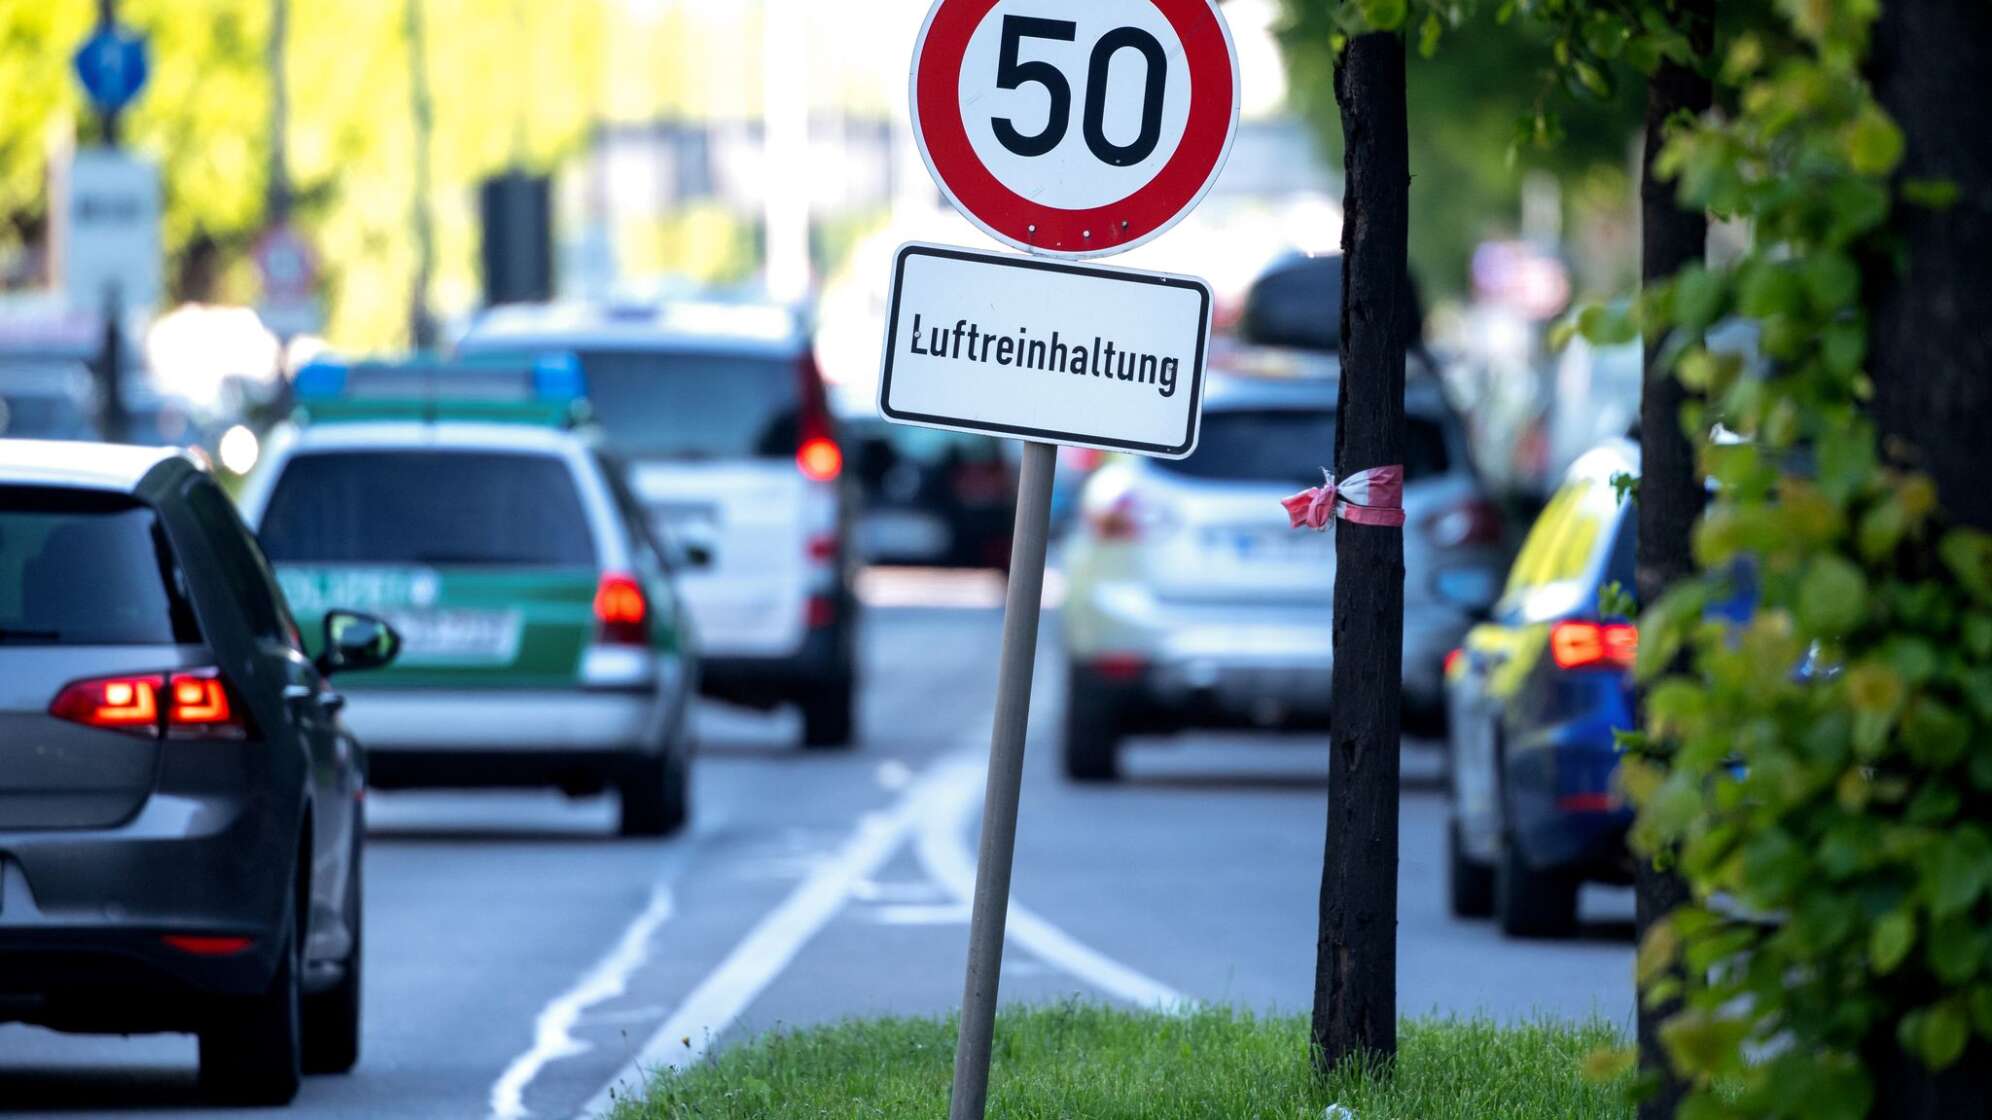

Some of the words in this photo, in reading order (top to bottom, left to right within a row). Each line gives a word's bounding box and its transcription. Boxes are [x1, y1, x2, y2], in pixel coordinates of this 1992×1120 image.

[990, 14, 1168, 167] 50
[910, 313, 1179, 398] Luftreinhaltung
[275, 568, 402, 608] OLIZEI
